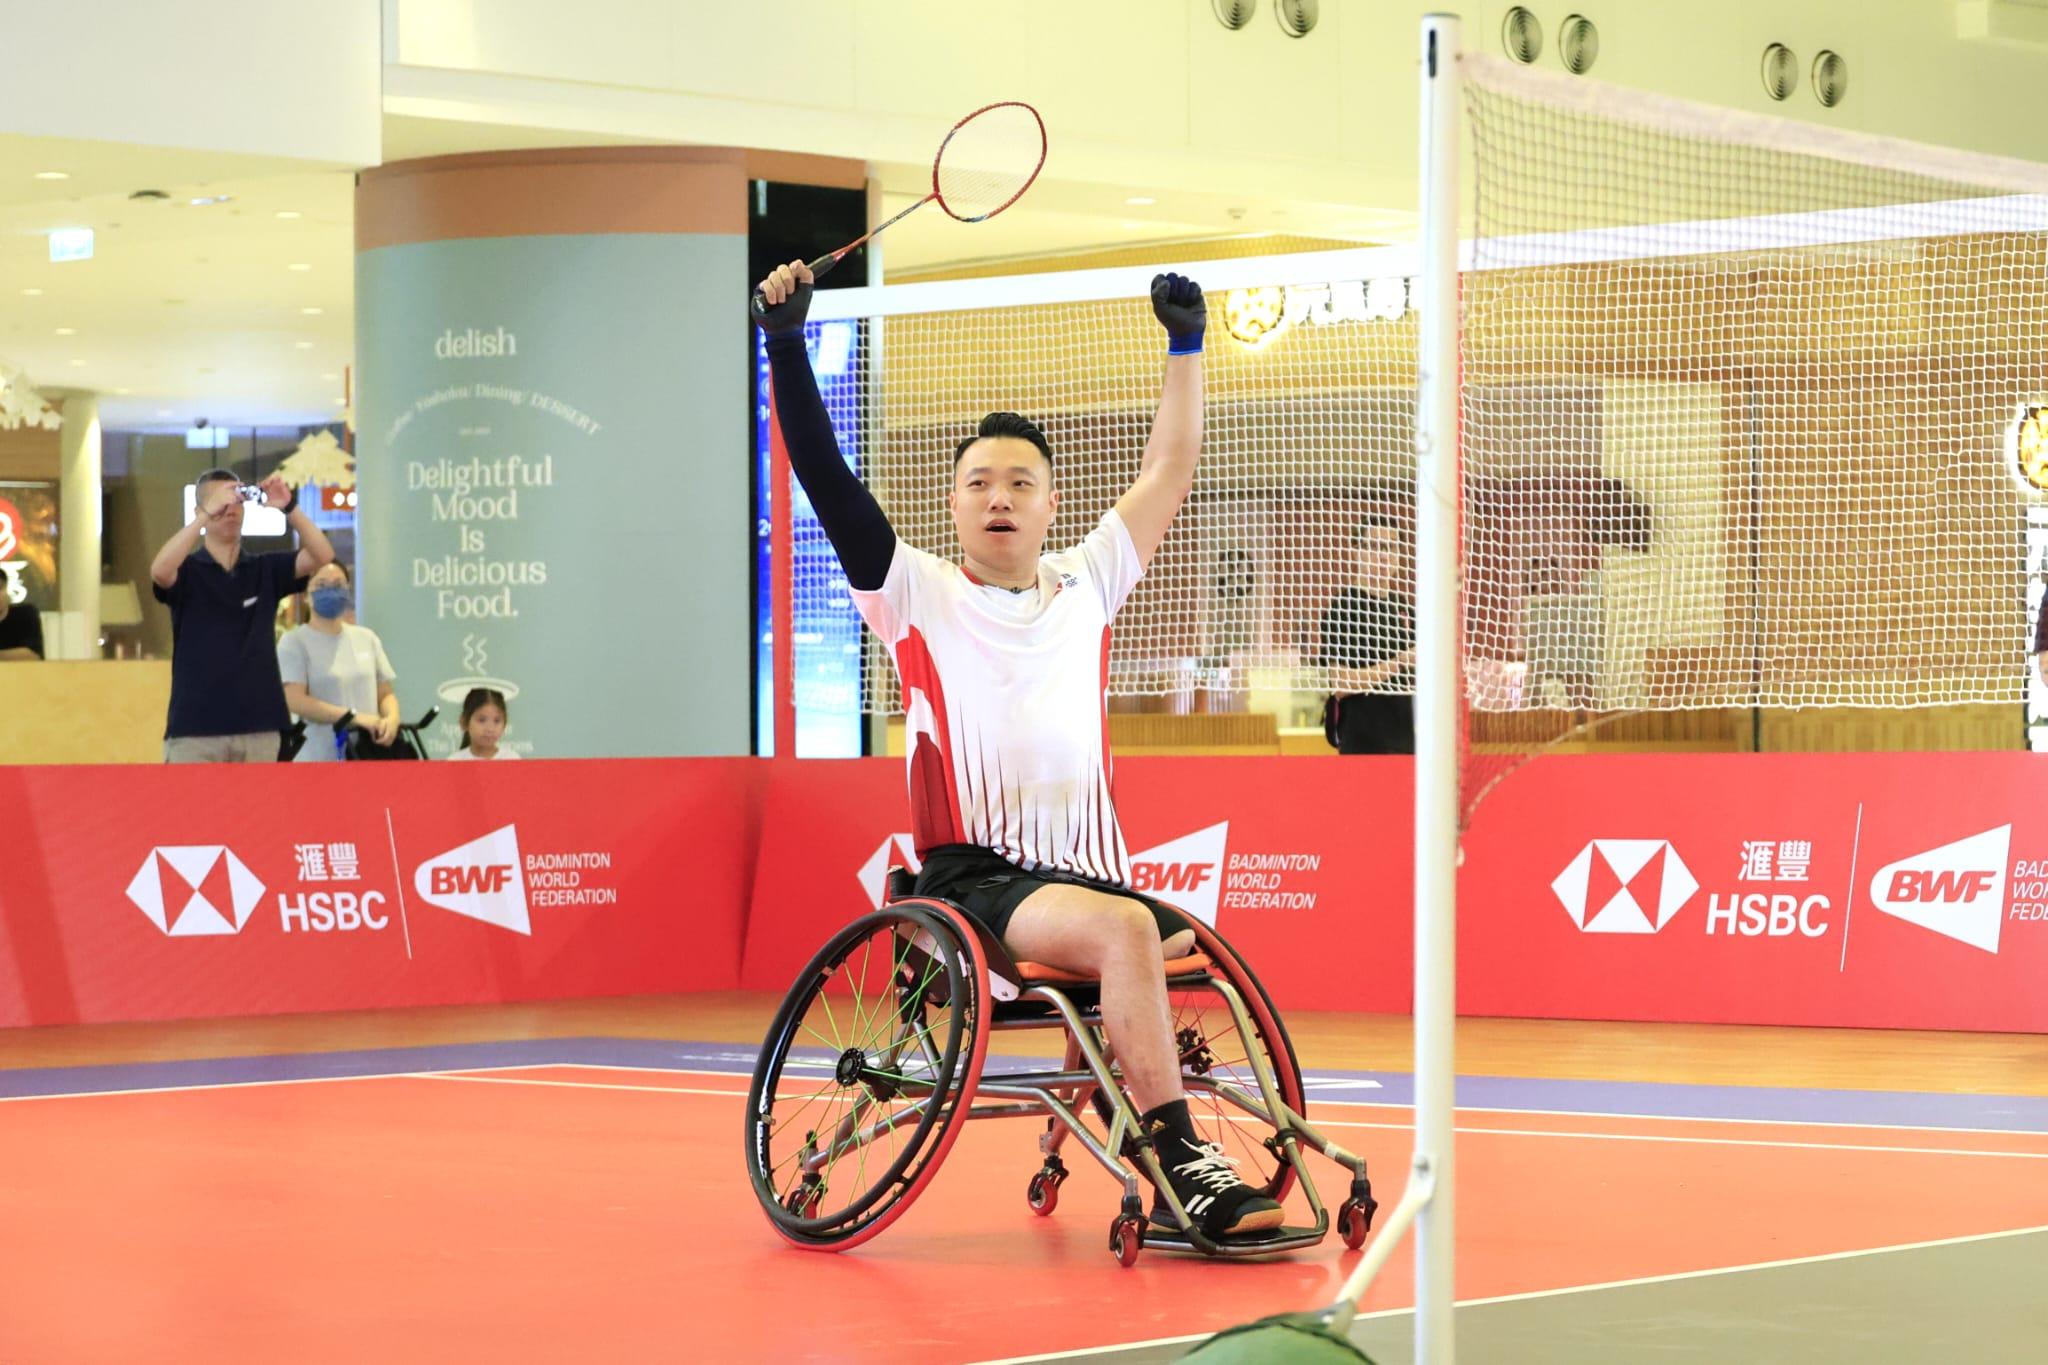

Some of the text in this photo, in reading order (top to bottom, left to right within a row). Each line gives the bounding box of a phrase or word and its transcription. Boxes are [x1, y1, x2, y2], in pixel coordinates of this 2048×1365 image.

[434, 326, 517, 359] delish
[407, 454, 553, 496] Delightful
[431, 488, 519, 521] Mood
[461, 524, 485, 553] Is
[412, 554, 547, 588] Delicious
[437, 585, 519, 620] Food.
[526, 852, 611, 871] BADMINTON
[1228, 853, 1320, 871] BADMINTON
[430, 864, 514, 895] BWF
[529, 871, 580, 889] WORLD
[1131, 862, 1215, 893] BWF
[1227, 872, 1281, 890] WORLD
[1886, 870, 1997, 903] BWF
[278, 889, 389, 933] HSBC
[532, 888, 617, 907] FEDERATION
[1223, 891, 1317, 910] FEDERATION
[1705, 893, 1831, 938] HSBC
